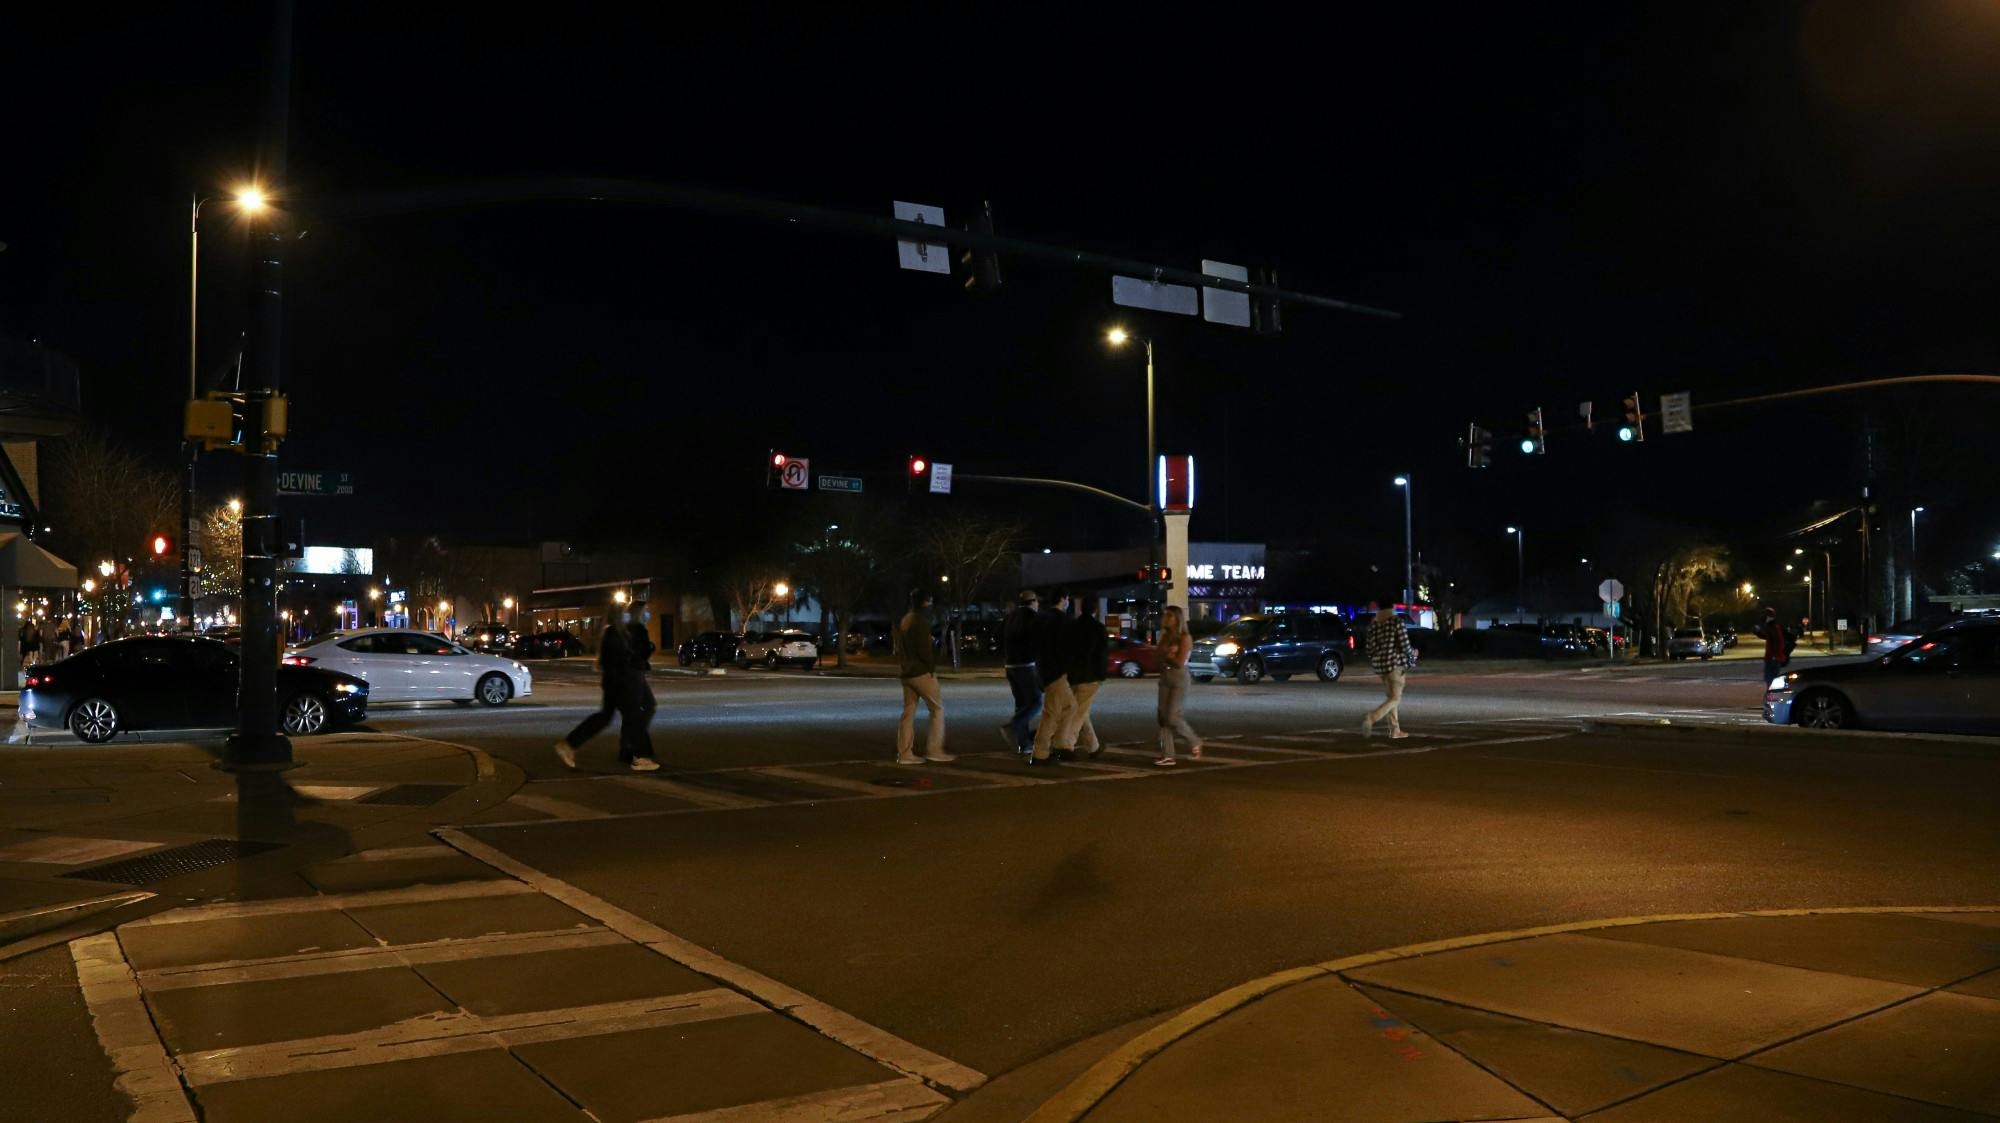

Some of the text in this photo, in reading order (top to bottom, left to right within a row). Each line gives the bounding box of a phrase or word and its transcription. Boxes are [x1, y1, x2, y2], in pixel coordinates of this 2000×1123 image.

[281, 472, 349, 491] DEVINE ST
[821, 479, 849, 489] DEVINE
[1221, 565, 1265, 579] TEAM
